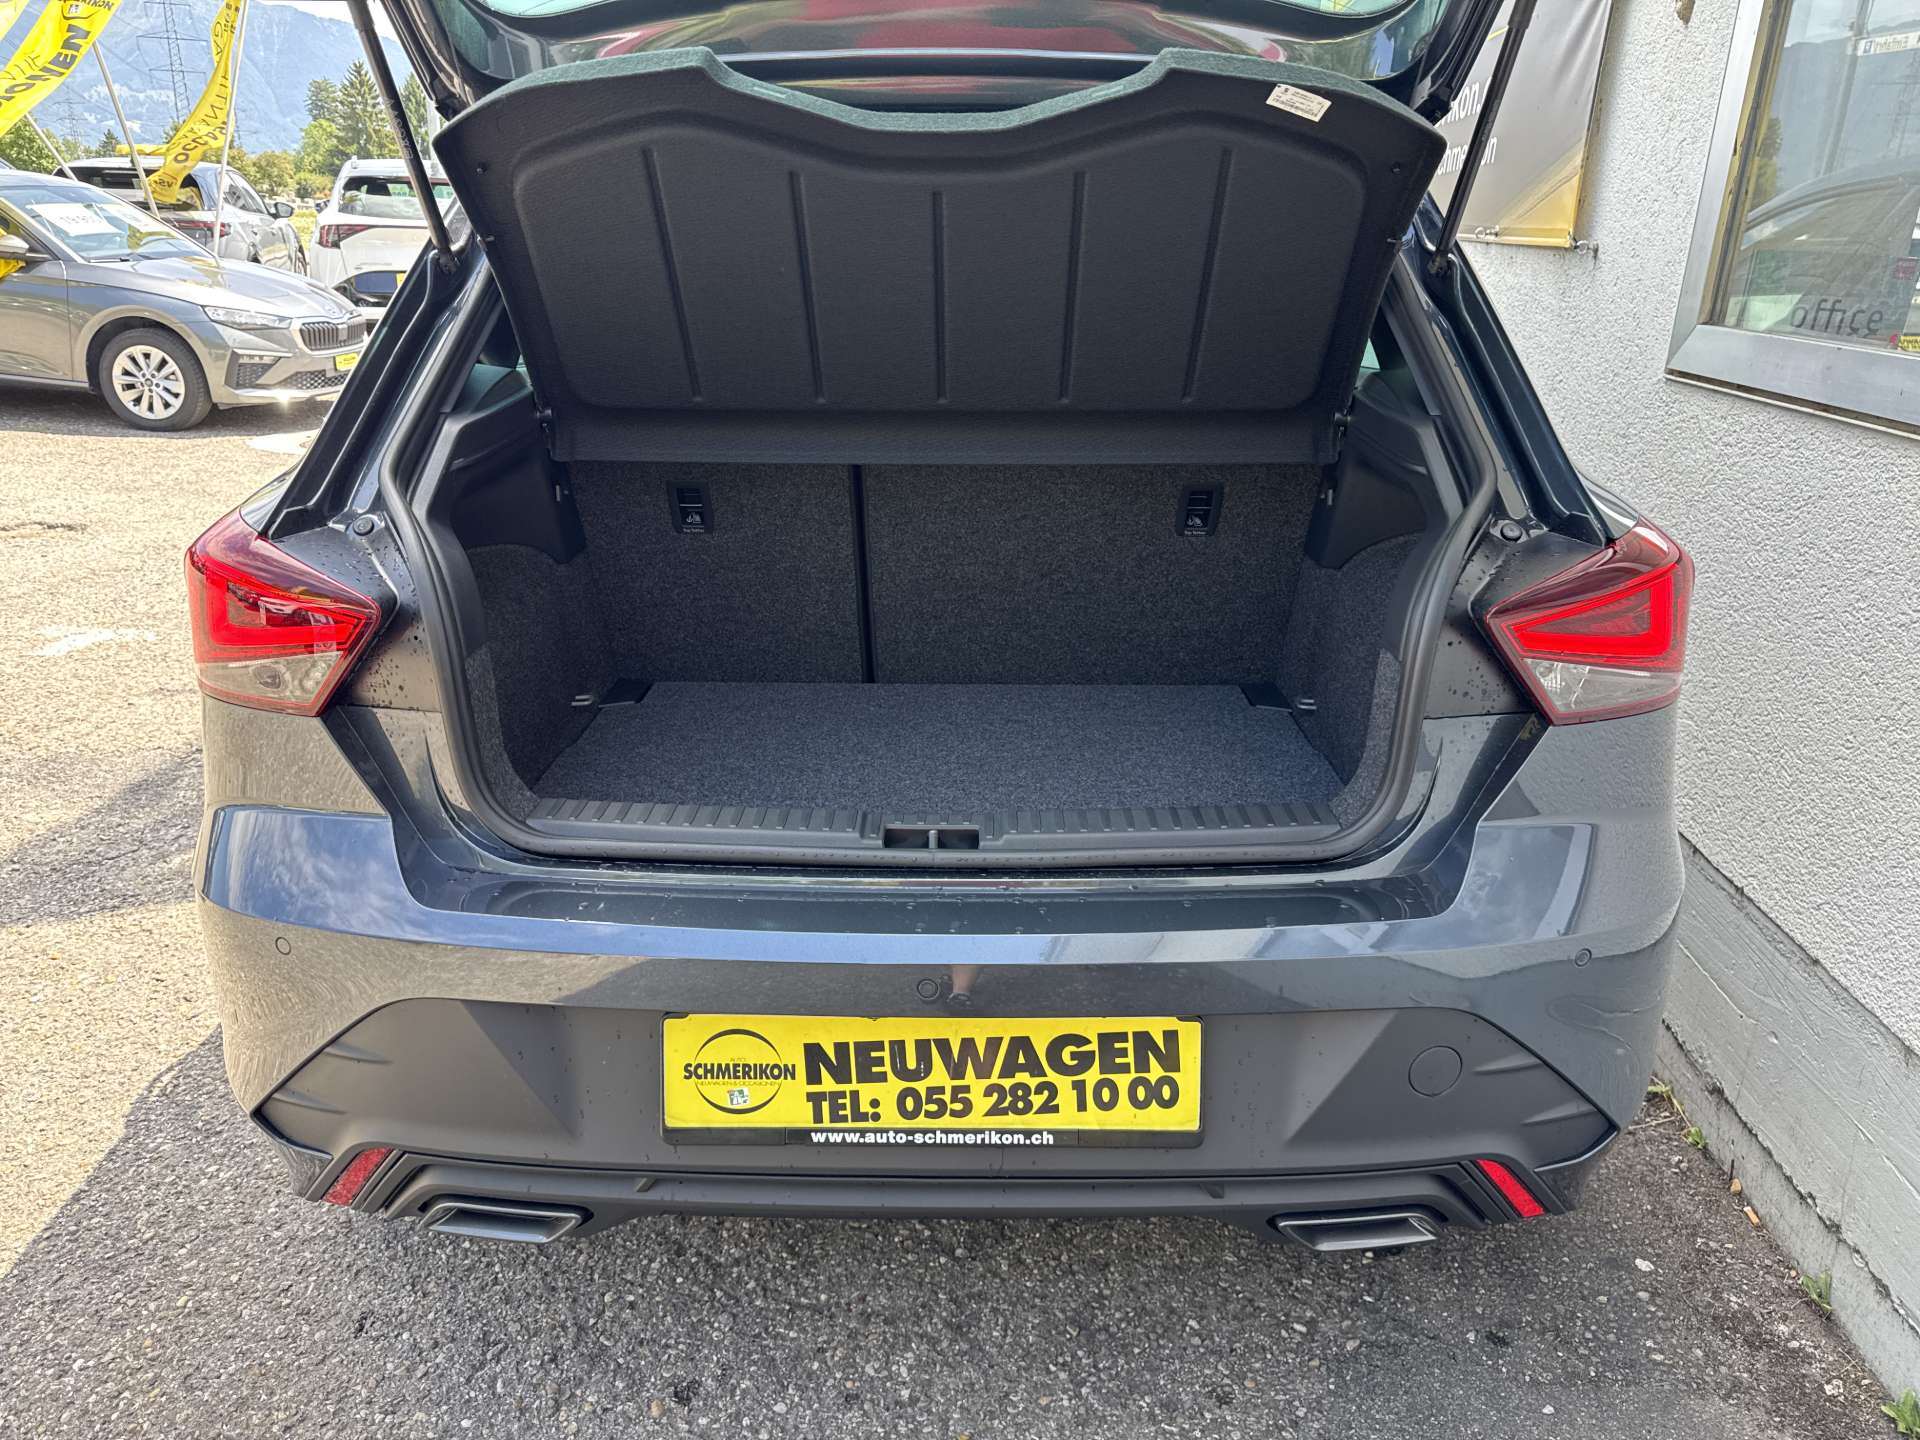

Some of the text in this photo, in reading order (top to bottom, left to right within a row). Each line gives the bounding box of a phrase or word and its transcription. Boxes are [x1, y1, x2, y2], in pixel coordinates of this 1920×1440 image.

[1791, 298, 1884, 336] office
[683, 1062, 796, 1081] SCHMERIKON
[803, 1029, 1181, 1086] NEUWAGEN
[806, 1075, 1180, 1124] TEL: 055 282 10 00
[810, 1130, 1055, 1146] www.auto-schmerikon.ch
